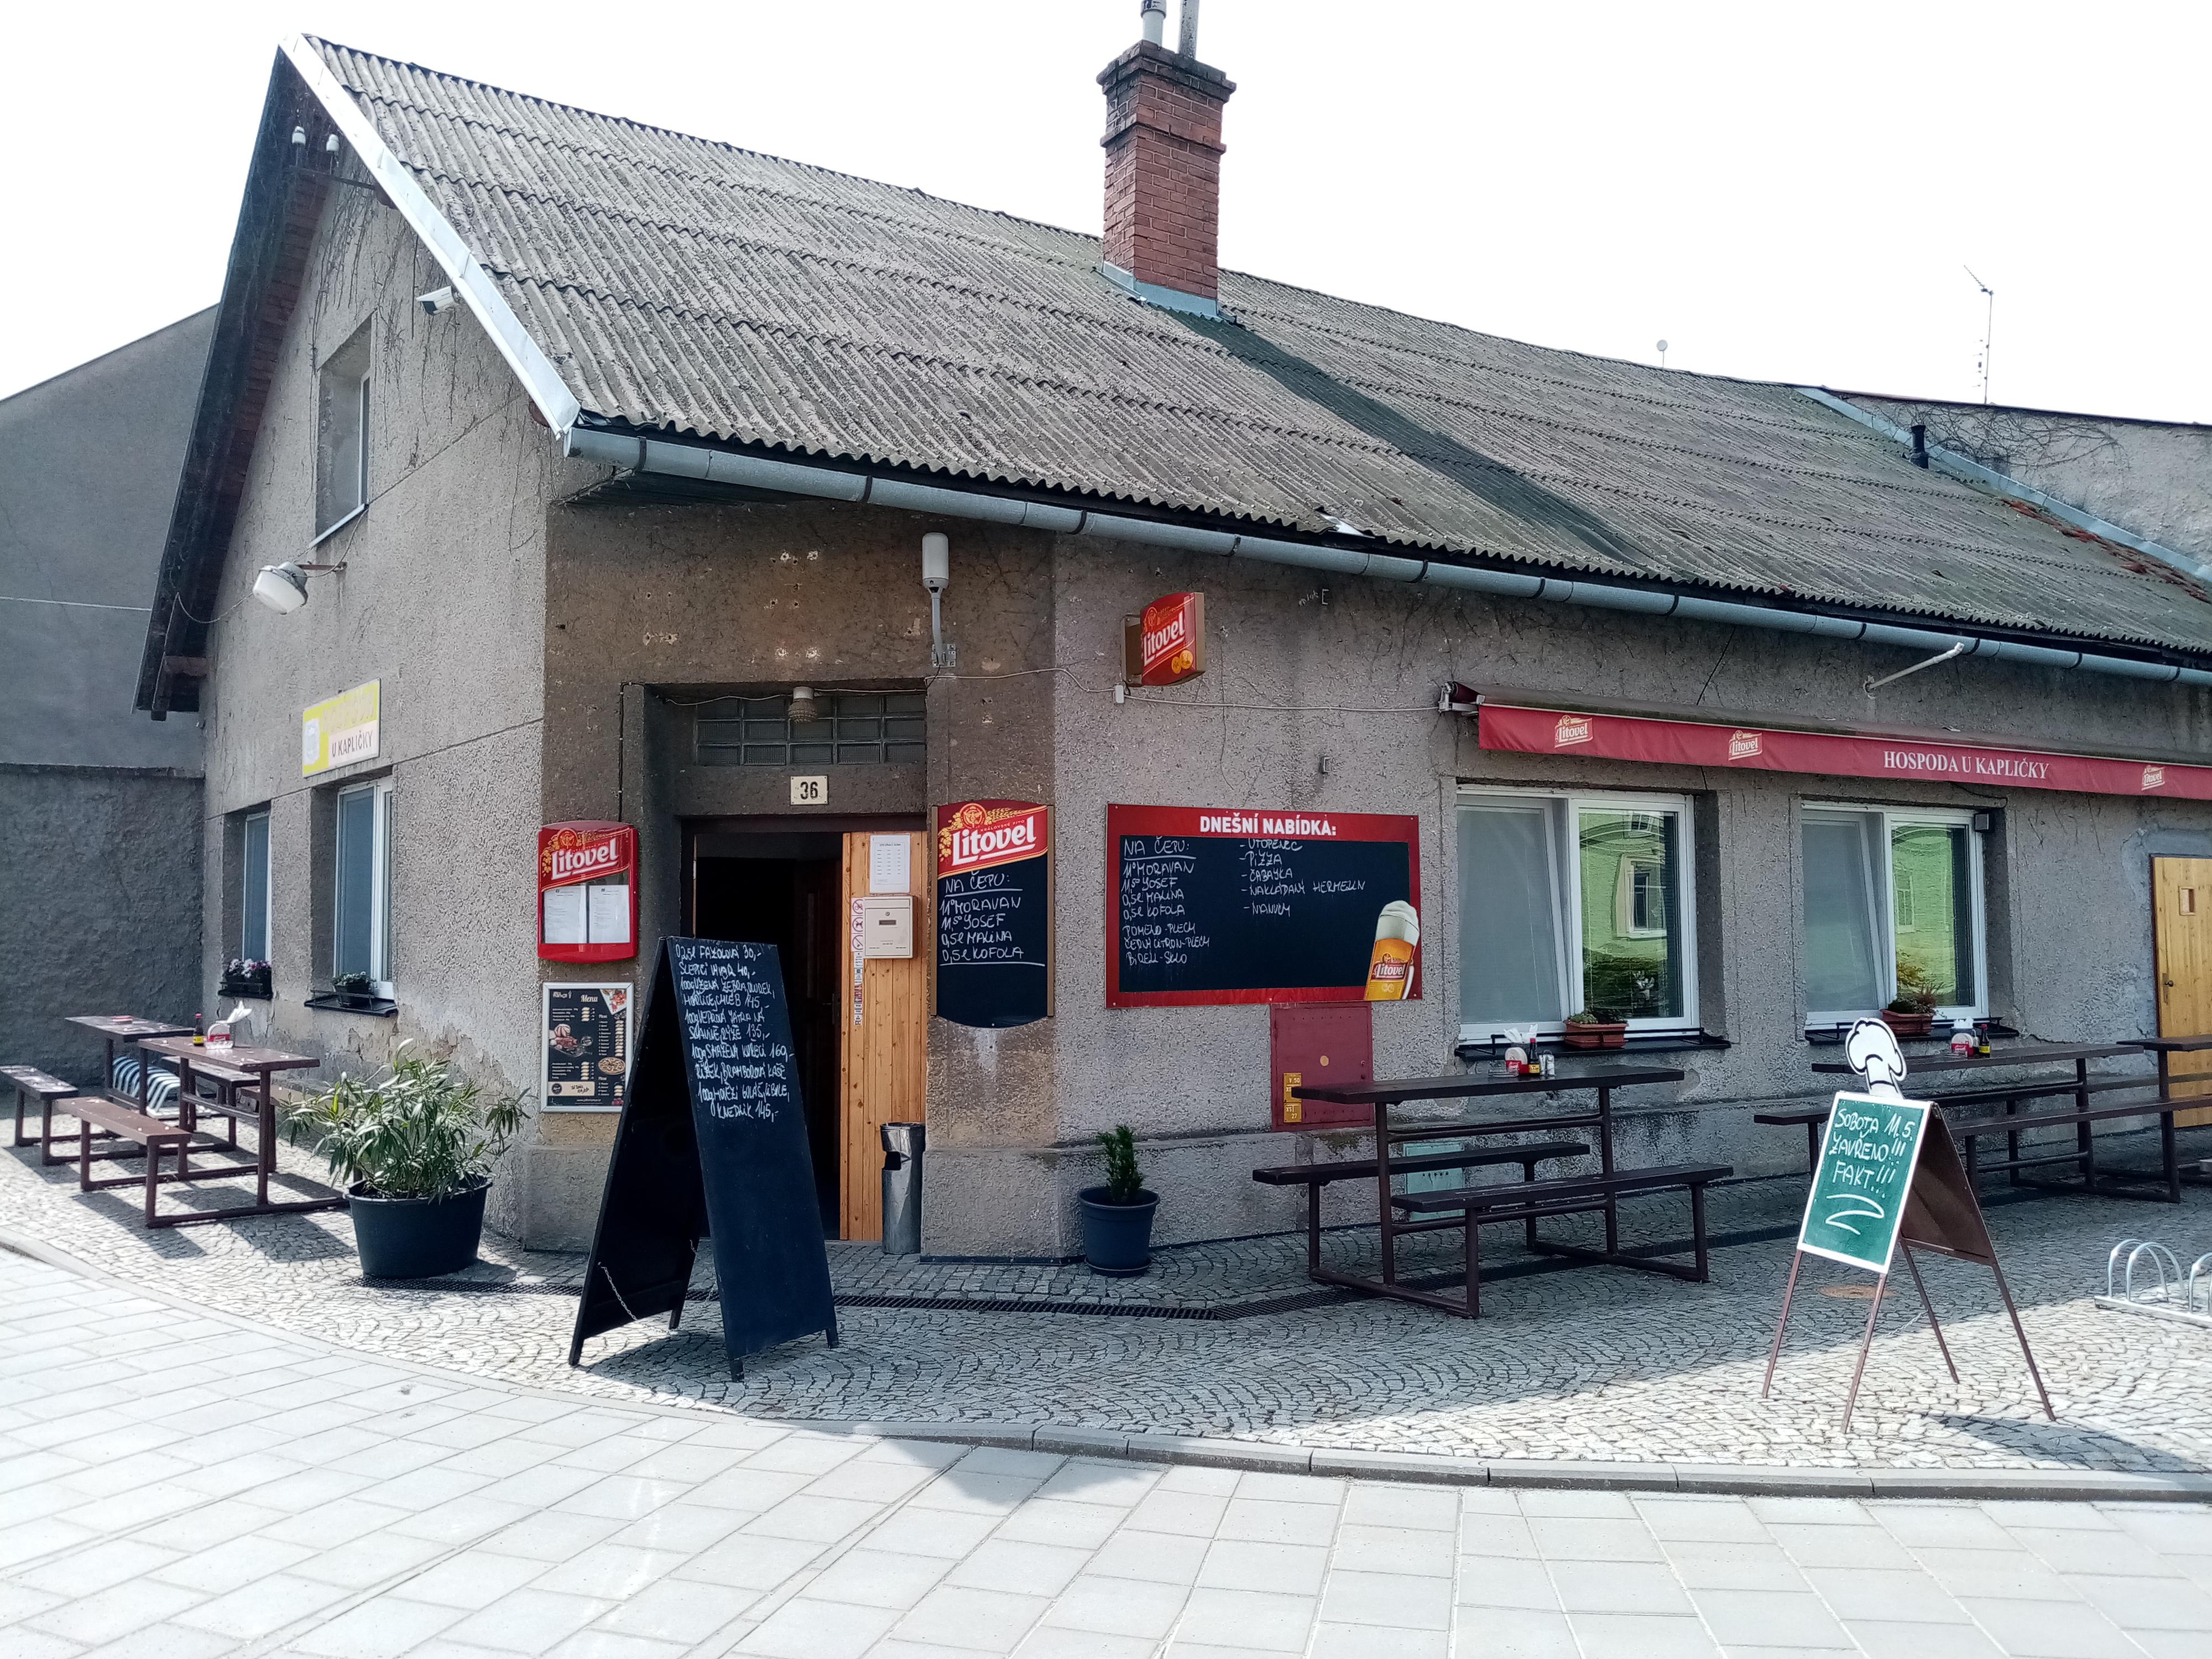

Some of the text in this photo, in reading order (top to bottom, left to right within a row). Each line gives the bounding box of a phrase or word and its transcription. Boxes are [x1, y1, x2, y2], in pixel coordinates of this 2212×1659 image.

[1143, 611, 1185, 667] Litovel
[1558, 722, 1588, 743] Litovel
[332, 731, 374, 758] U KAPLIČKY
[1731, 737, 1759, 757] Litovel
[1884, 751, 2049, 779] HOSPODA U KAPLIČKY
[800, 781, 818, 800] 36
[1200, 812, 1337, 836] DNEŠNÍ NABÍDKA:
[952, 816, 1037, 867] Litovel
[1124, 836, 1190, 857] NA ČEPU:
[551, 838, 619, 880] Litovel
[1137, 860, 1194, 877] MORAVAN
[945, 870, 1011, 893] NA ČEPU:
[954, 896, 1021, 913] MORAVAN
[1147, 904, 1186, 917] KOFOLA
[972, 946, 1025, 959] KOFOLA
[1375, 963, 1405, 979] Litovel
[581, 994, 598, 1003] Menu
[1834, 1108, 1879, 1134] SOBOTA
